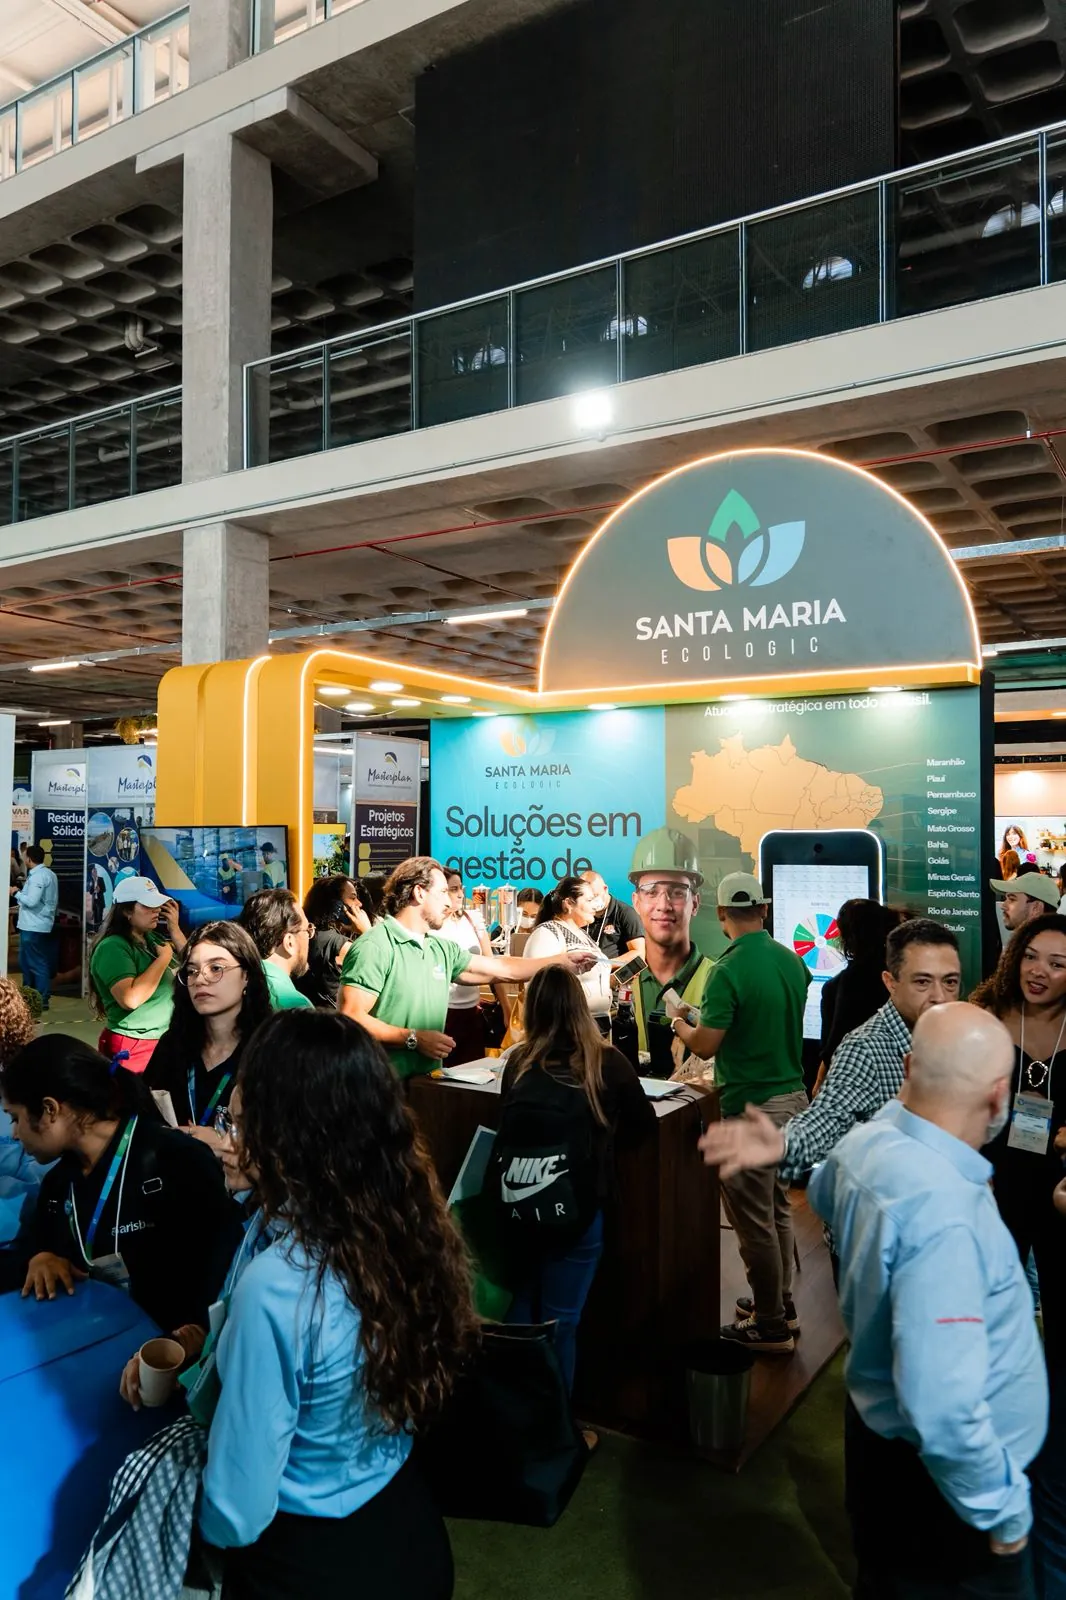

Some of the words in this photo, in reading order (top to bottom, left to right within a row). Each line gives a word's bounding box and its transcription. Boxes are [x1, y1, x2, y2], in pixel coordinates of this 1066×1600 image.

[635, 609, 733, 641] SANTA
[743, 598, 847, 631] MARIA
[661, 636, 819, 665] ECOLOGIC
[825, 699, 847, 710] em
[848, 697, 878, 709] todo
[926, 757, 966, 766] Maranhão
[367, 768, 412, 784] Masterplan
[485, 765, 526, 778] SANTA
[530, 763, 571, 776] MARIA
[495, 780, 561, 790] ECOLOGIC
[926, 774, 947, 783] Piauí
[48, 781, 86, 795] Masterpl
[118, 777, 157, 794] Masterpl
[926, 790, 977, 799] Pernambuco
[47, 812, 86, 823] Resíduo
[369, 809, 405, 824] Projetos
[927, 807, 958, 816] Sergipe
[446, 804, 582, 846] Soluções
[588, 811, 641, 837] em
[927, 824, 947, 833] Mato
[947, 824, 976, 833] Grosso
[361, 824, 414, 840] Estratégicos
[927, 841, 949, 849] Bahia
[551, 848, 593, 881] de
[927, 857, 950, 865] Goiás
[927, 873, 950, 881] Minas
[950, 873, 976, 882] Gerais
[927, 889, 957, 898] Espírito
[957, 890, 980, 898] Santo
[927, 907, 940, 915] Rio
[941, 907, 951, 916] de
[951, 908, 979, 917] Janeiro
[505, 1155, 559, 1184] NIKE
[511, 1202, 566, 1222] AIR
